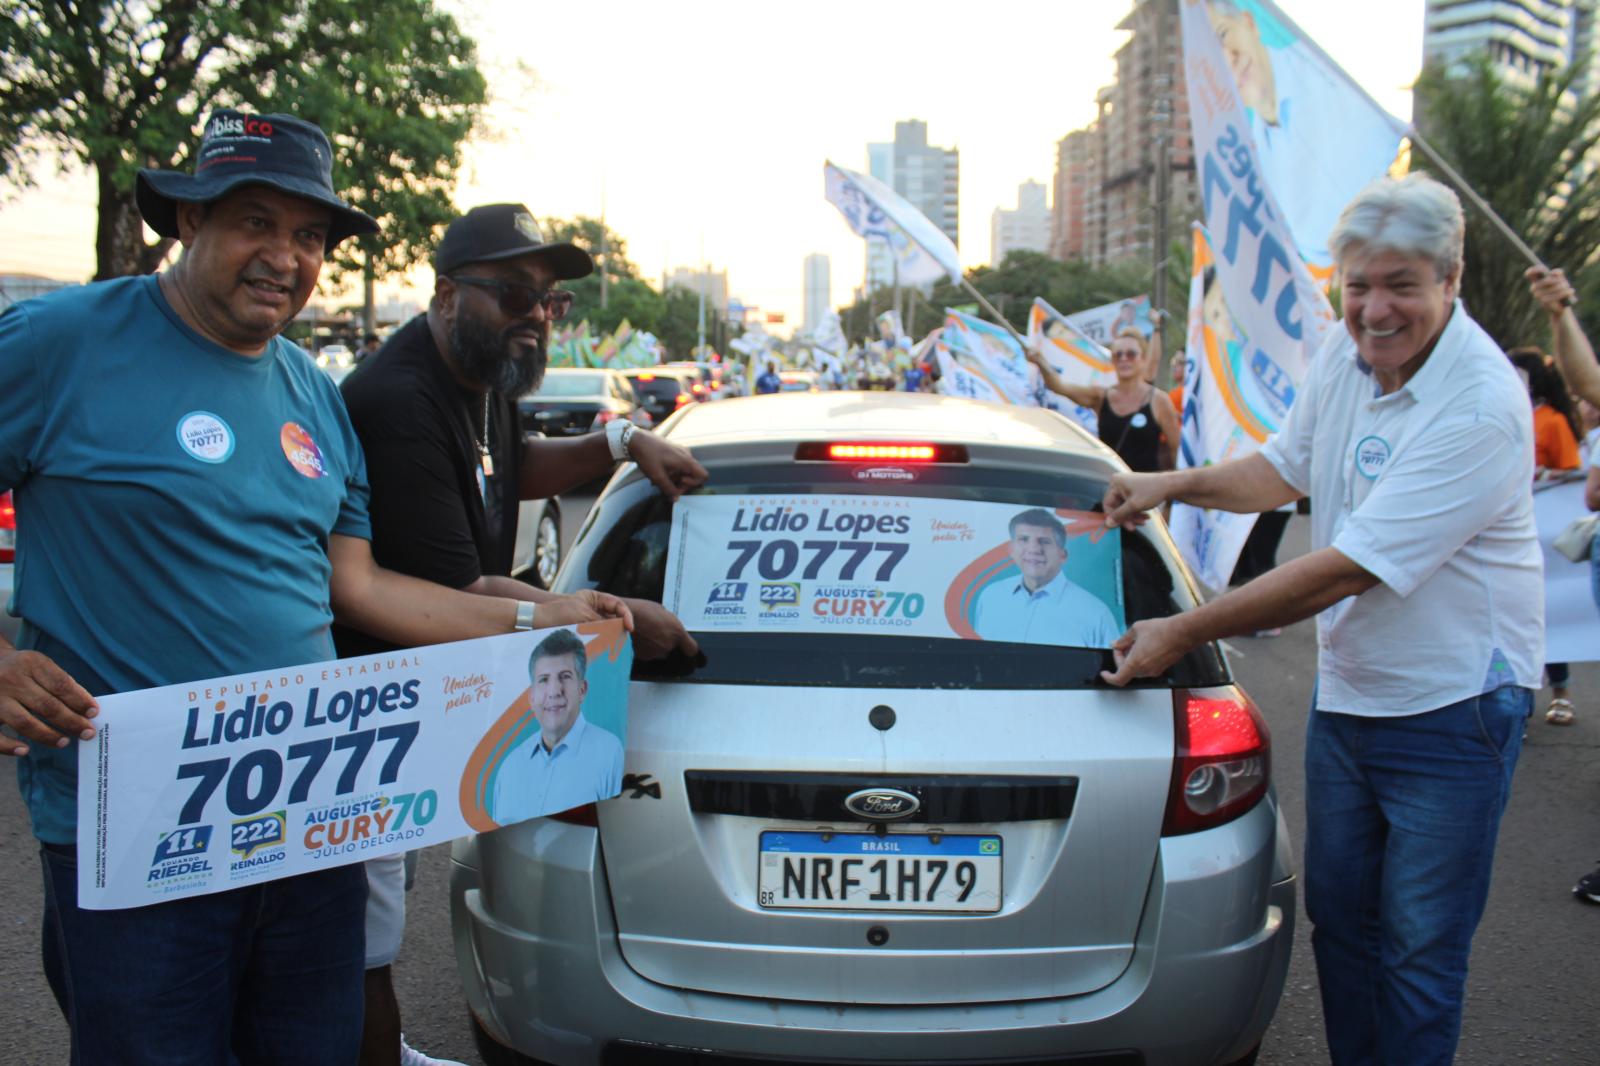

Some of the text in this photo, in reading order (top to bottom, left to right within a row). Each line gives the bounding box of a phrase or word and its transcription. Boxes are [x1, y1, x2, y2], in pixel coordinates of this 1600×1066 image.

[189, 433, 223, 448] 70777
[738, 497, 911, 509] DEPUTADO ESTADUAL
[732, 506, 911, 540] Lidio Lopes
[726, 539, 910, 582] 70777
[760, 586, 795, 600] 222
[704, 606, 747, 615] RIEDEL
[813, 591, 925, 619] CURY 70
[857, 617, 912, 626] DELGADO
[188, 656, 421, 701] DEPUTADO ESTADUAL
[442, 673, 487, 695] Unidos
[181, 678, 421, 749] Lidio Lopes
[445, 692, 472, 715] pela
[176, 720, 420, 825] 70777
[863, 795, 902, 812] Ford
[303, 789, 438, 850] CURY 70
[232, 819, 279, 845] 222
[360, 827, 425, 849] DELGADO
[861, 841, 901, 851] BRASIL
[147, 860, 213, 881] RIEDEL
[230, 851, 286, 870] REINALDO
[783, 857, 977, 902] NRF1H79
[761, 891, 775, 905] BR
